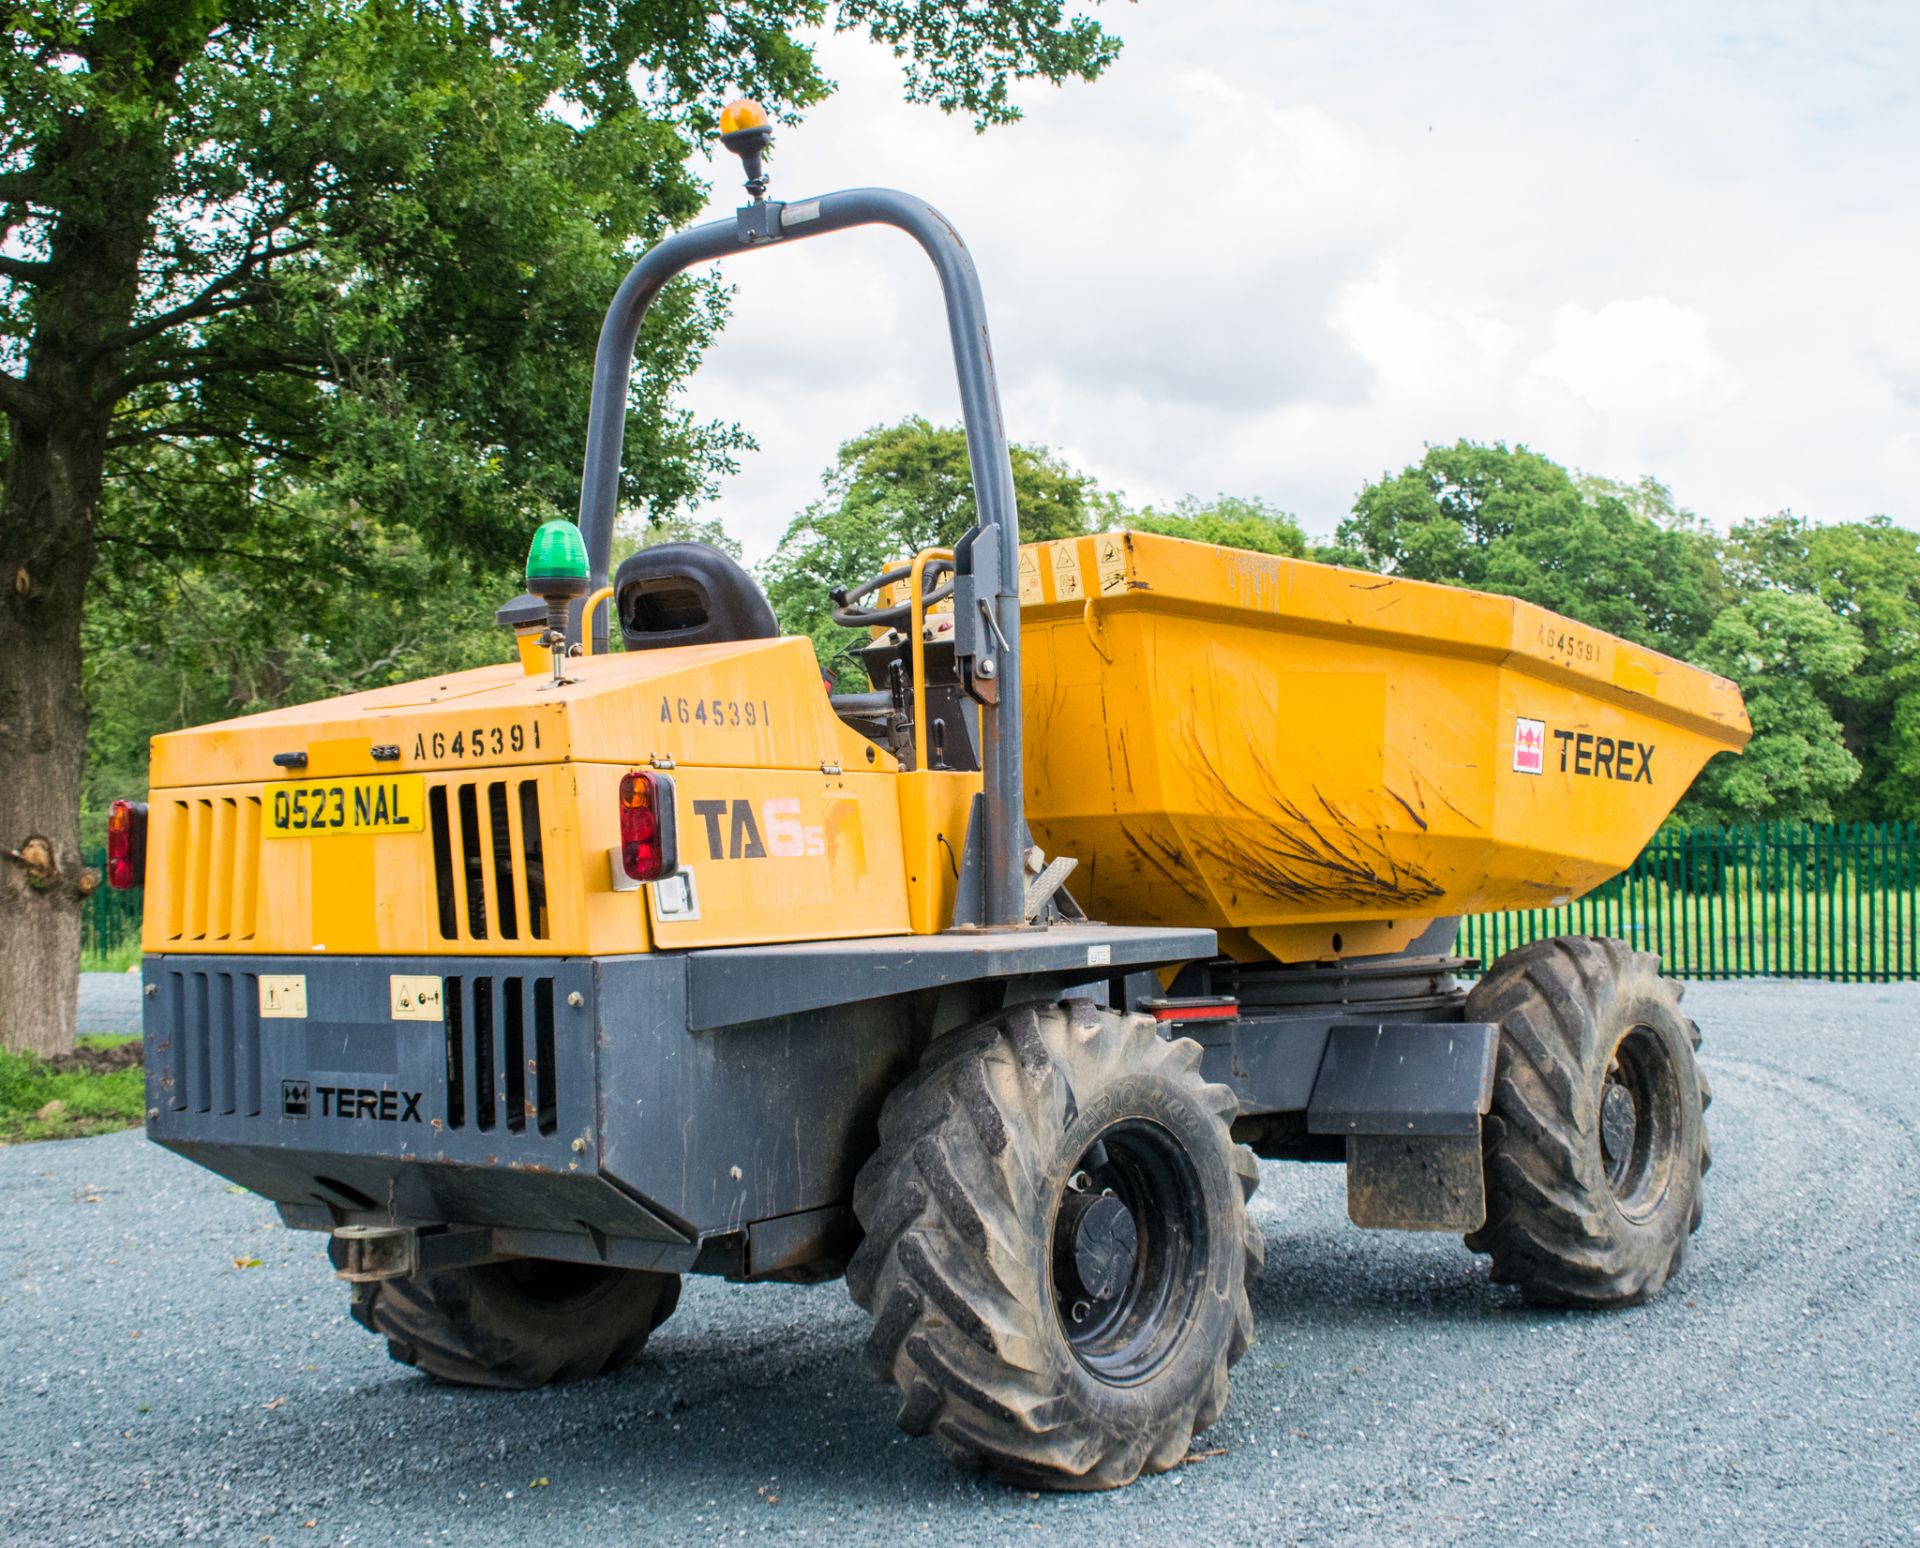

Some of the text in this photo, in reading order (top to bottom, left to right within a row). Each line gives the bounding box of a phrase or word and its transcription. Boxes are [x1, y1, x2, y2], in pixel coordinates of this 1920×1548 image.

[660, 695, 770, 727] A645391
[414, 720, 541, 761] A645391
[1553, 729, 1656, 784] TEREX
[274, 783, 410, 829] Q523 NAL
[316, 1086, 423, 1123] TEREX
